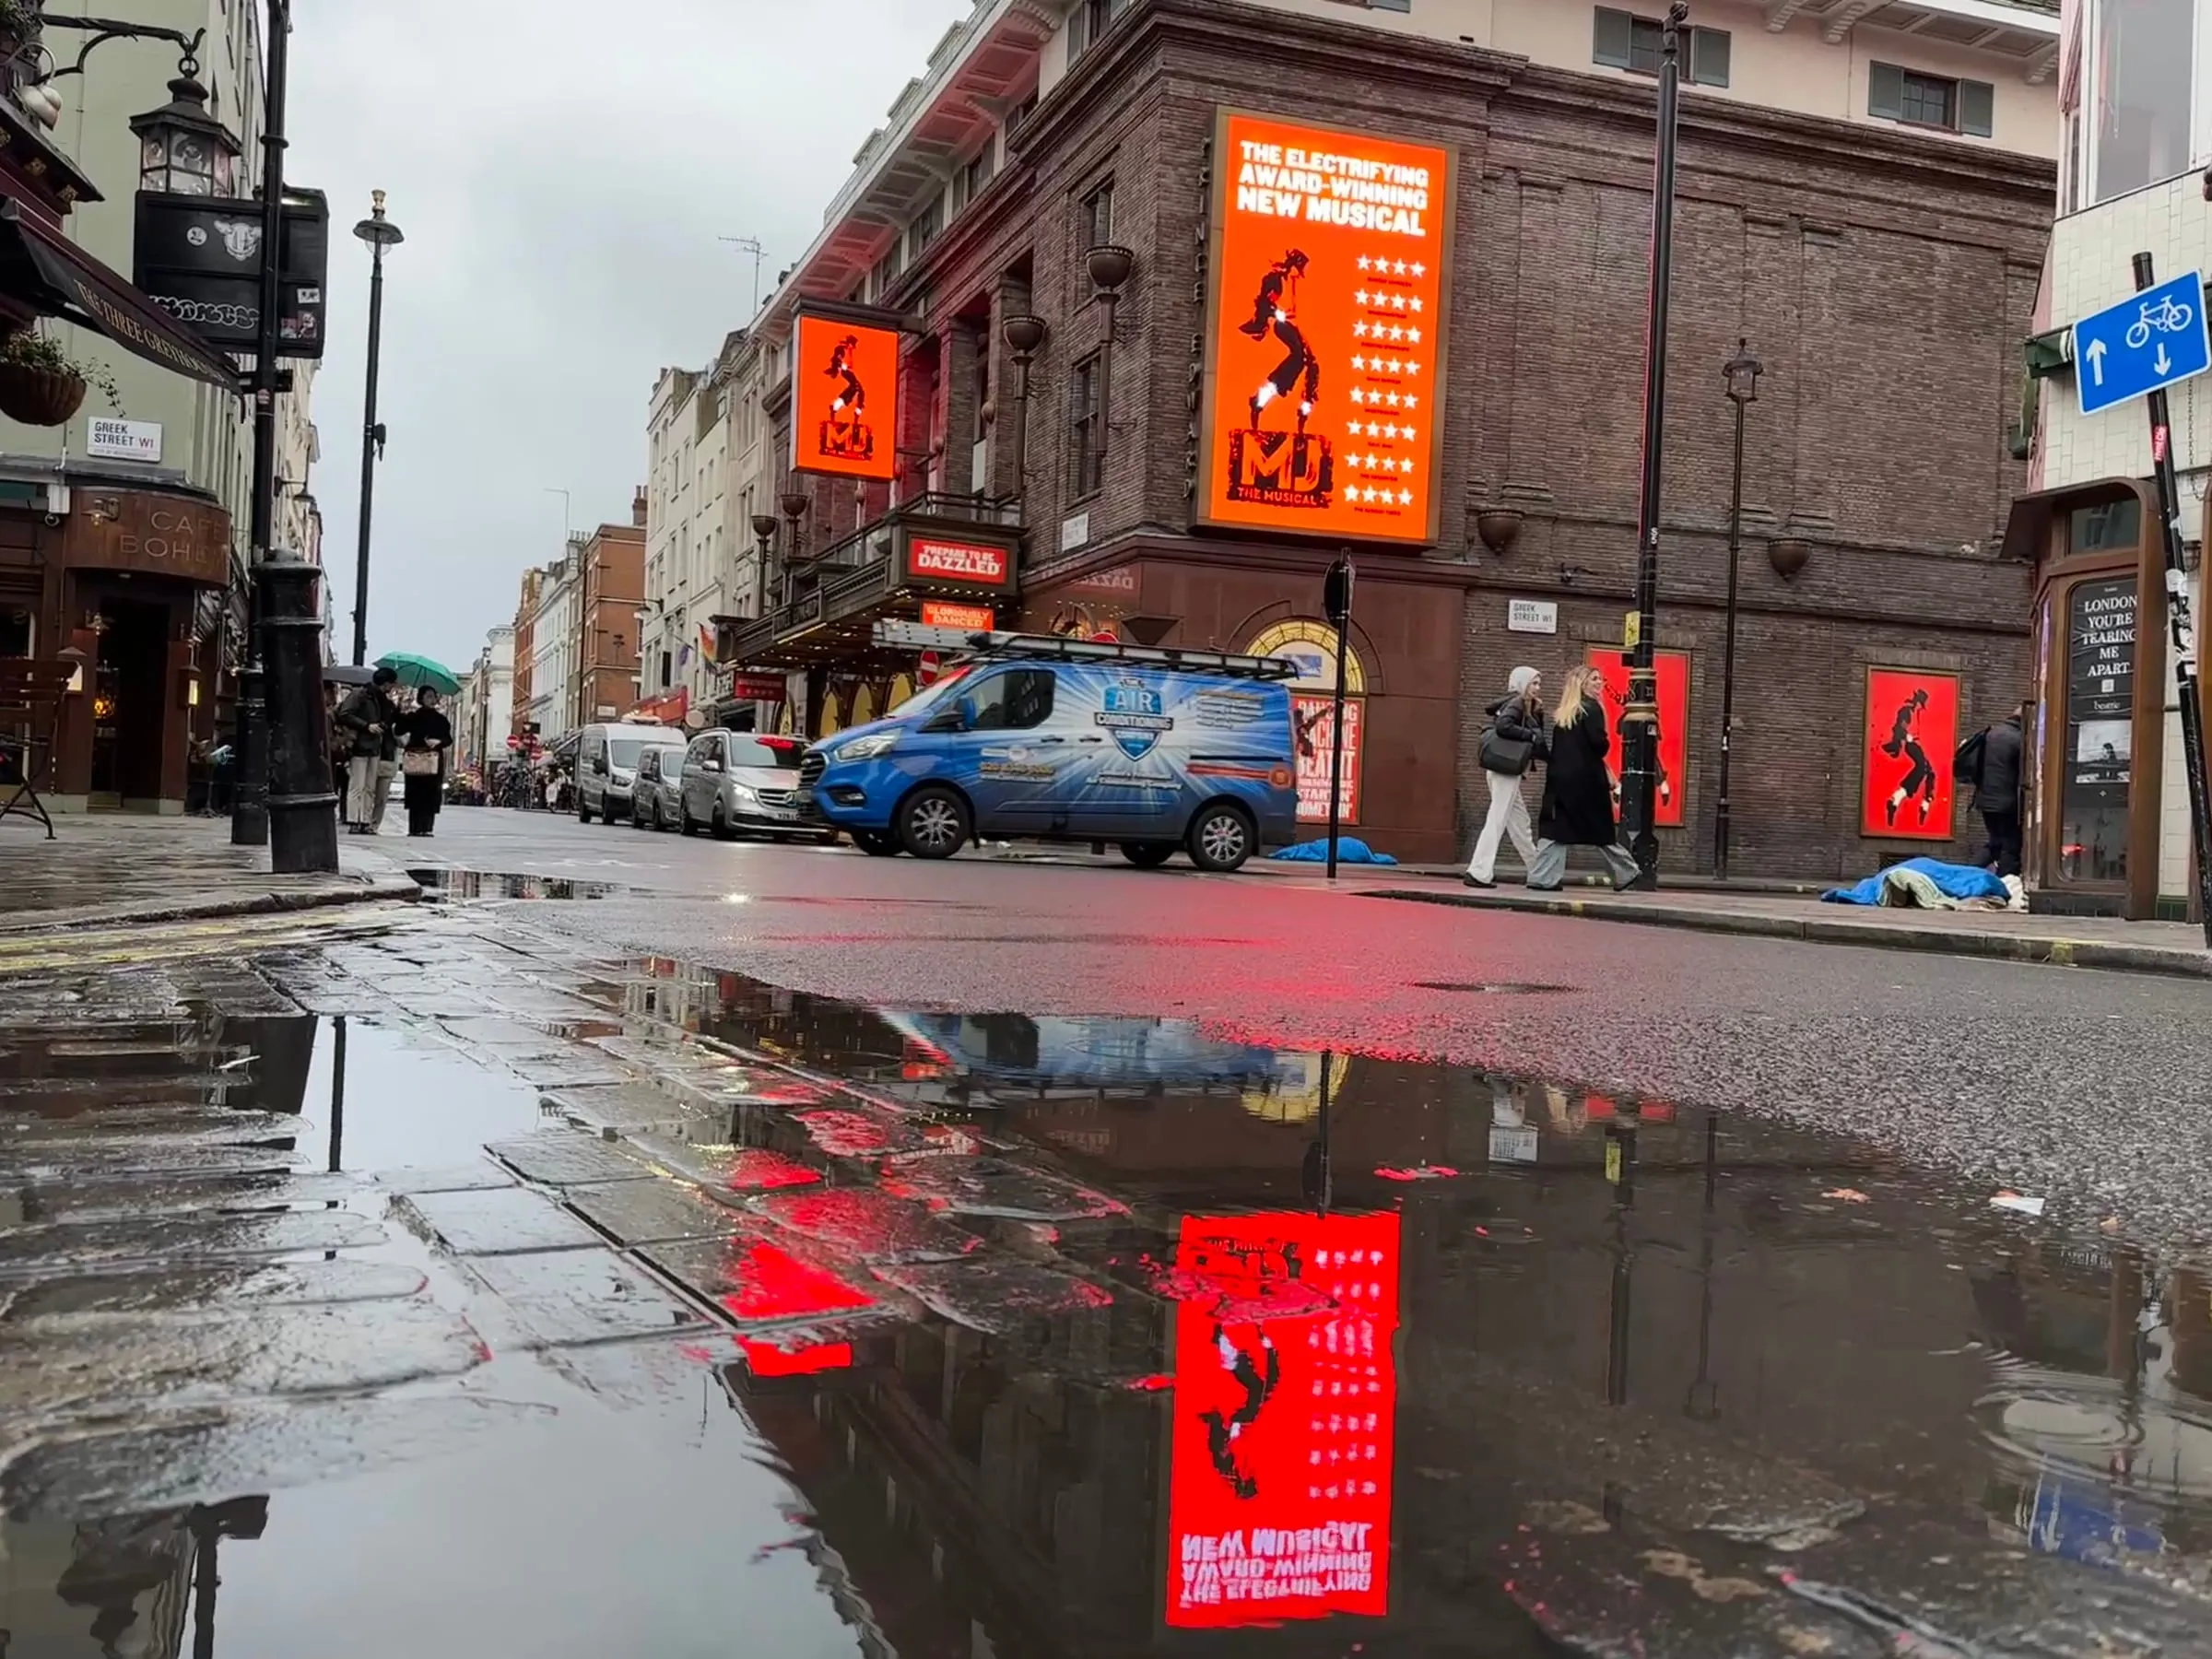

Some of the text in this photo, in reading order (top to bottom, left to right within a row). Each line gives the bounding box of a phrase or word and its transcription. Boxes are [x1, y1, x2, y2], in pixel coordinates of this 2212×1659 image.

[1240, 139, 1429, 188] THE ELECTRIFYING
[1239, 162, 1428, 210] AWARD-WINNING
[1237, 184, 1426, 236] NEW MUSICAL
[74, 278, 103, 316] THE
[100, 299, 144, 344] THREE
[94, 421, 128, 434] GREEK
[94, 433, 153, 449] STREET W1
[1241, 432, 1322, 491] MJ
[1237, 487, 1317, 505] THE MUSICAL
[969, 550, 981, 560] TO
[1513, 603, 1535, 612] GREEK
[2085, 595, 2137, 613] LONDON
[926, 606, 989, 620] GLORIOUSLY
[1513, 612, 1539, 622] STREET
[2088, 612, 2134, 628] YOU'RE
[932, 615, 984, 628] DANCED
[2100, 646, 2120, 659] ME
[2087, 662, 2130, 677] APART
[1114, 690, 1154, 712] AIR
